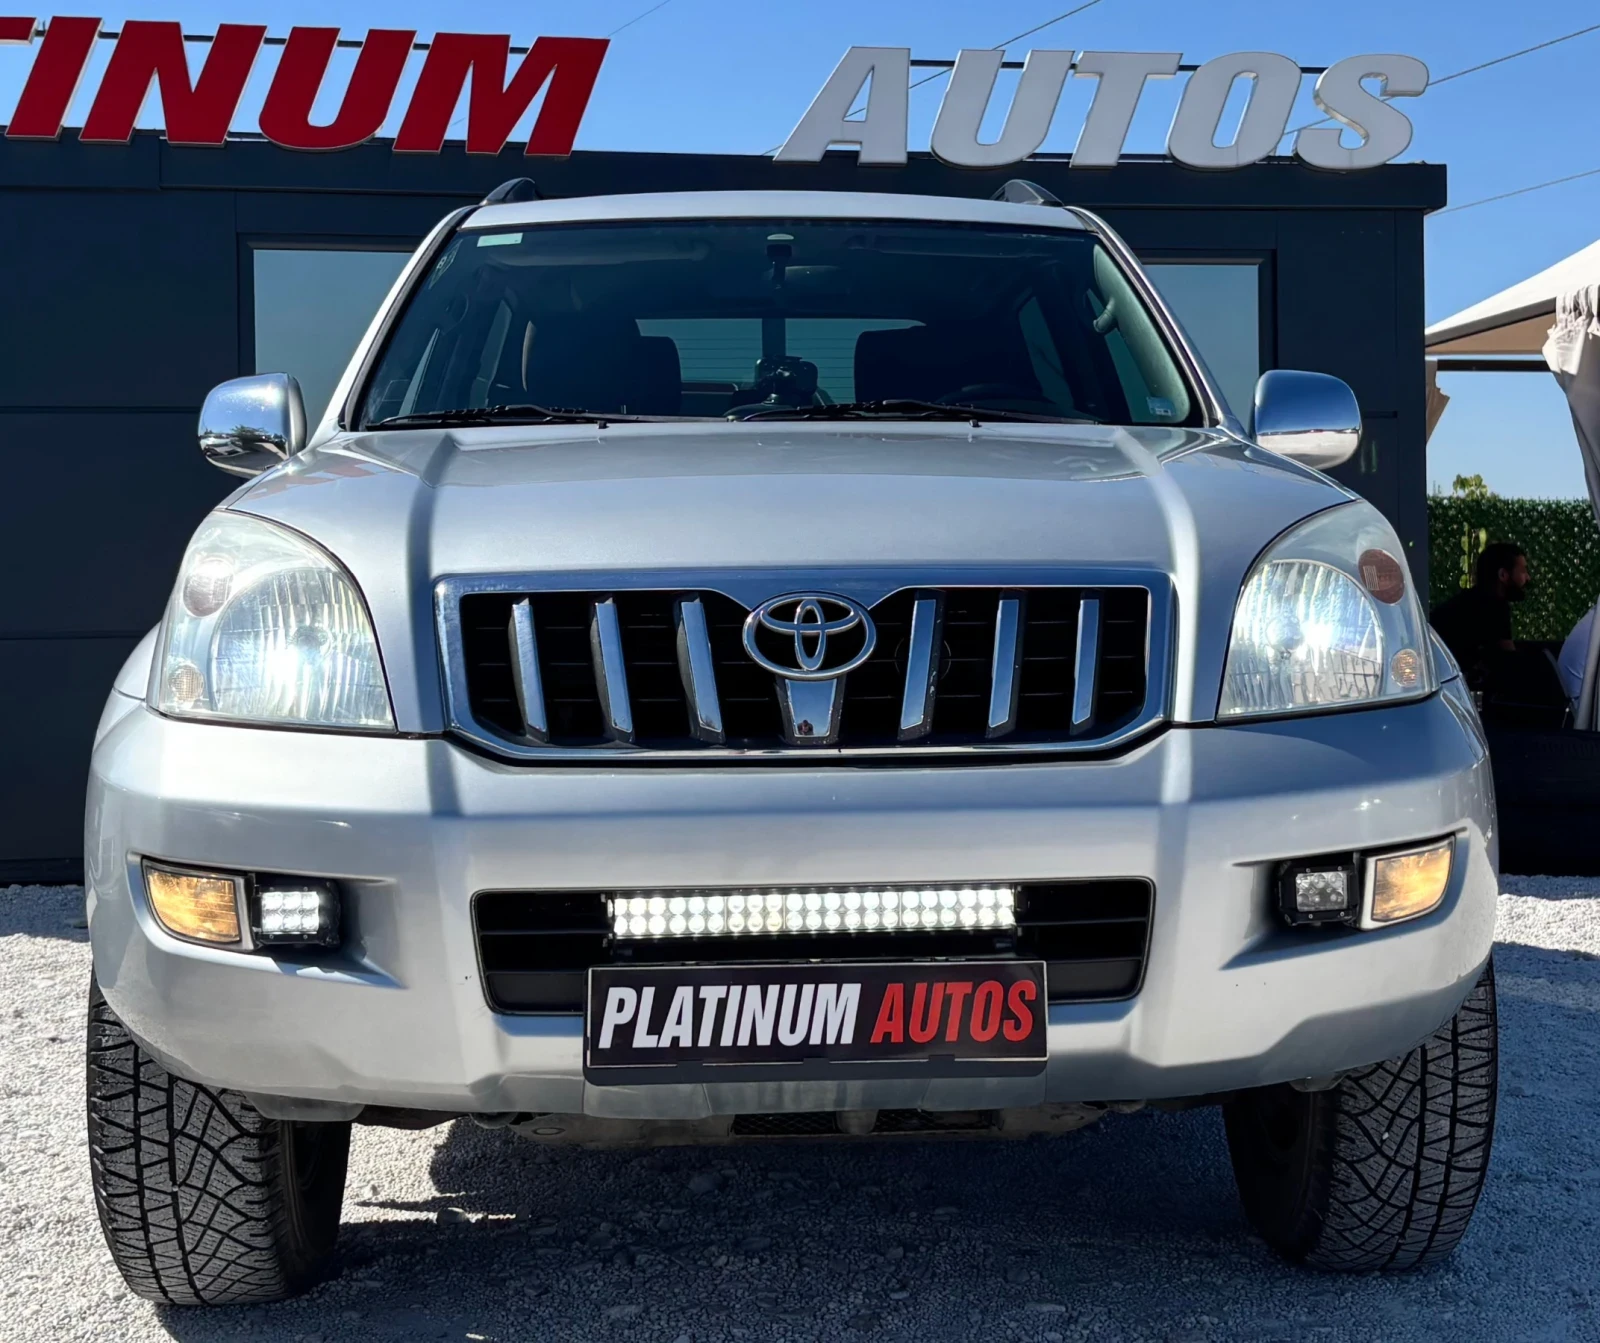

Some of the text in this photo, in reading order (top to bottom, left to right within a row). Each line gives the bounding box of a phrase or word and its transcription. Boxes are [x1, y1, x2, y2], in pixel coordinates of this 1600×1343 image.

[0, 15, 1429, 172] INUM AUTOS
[599, 980, 1037, 1049] PLATINUM AUTOS
